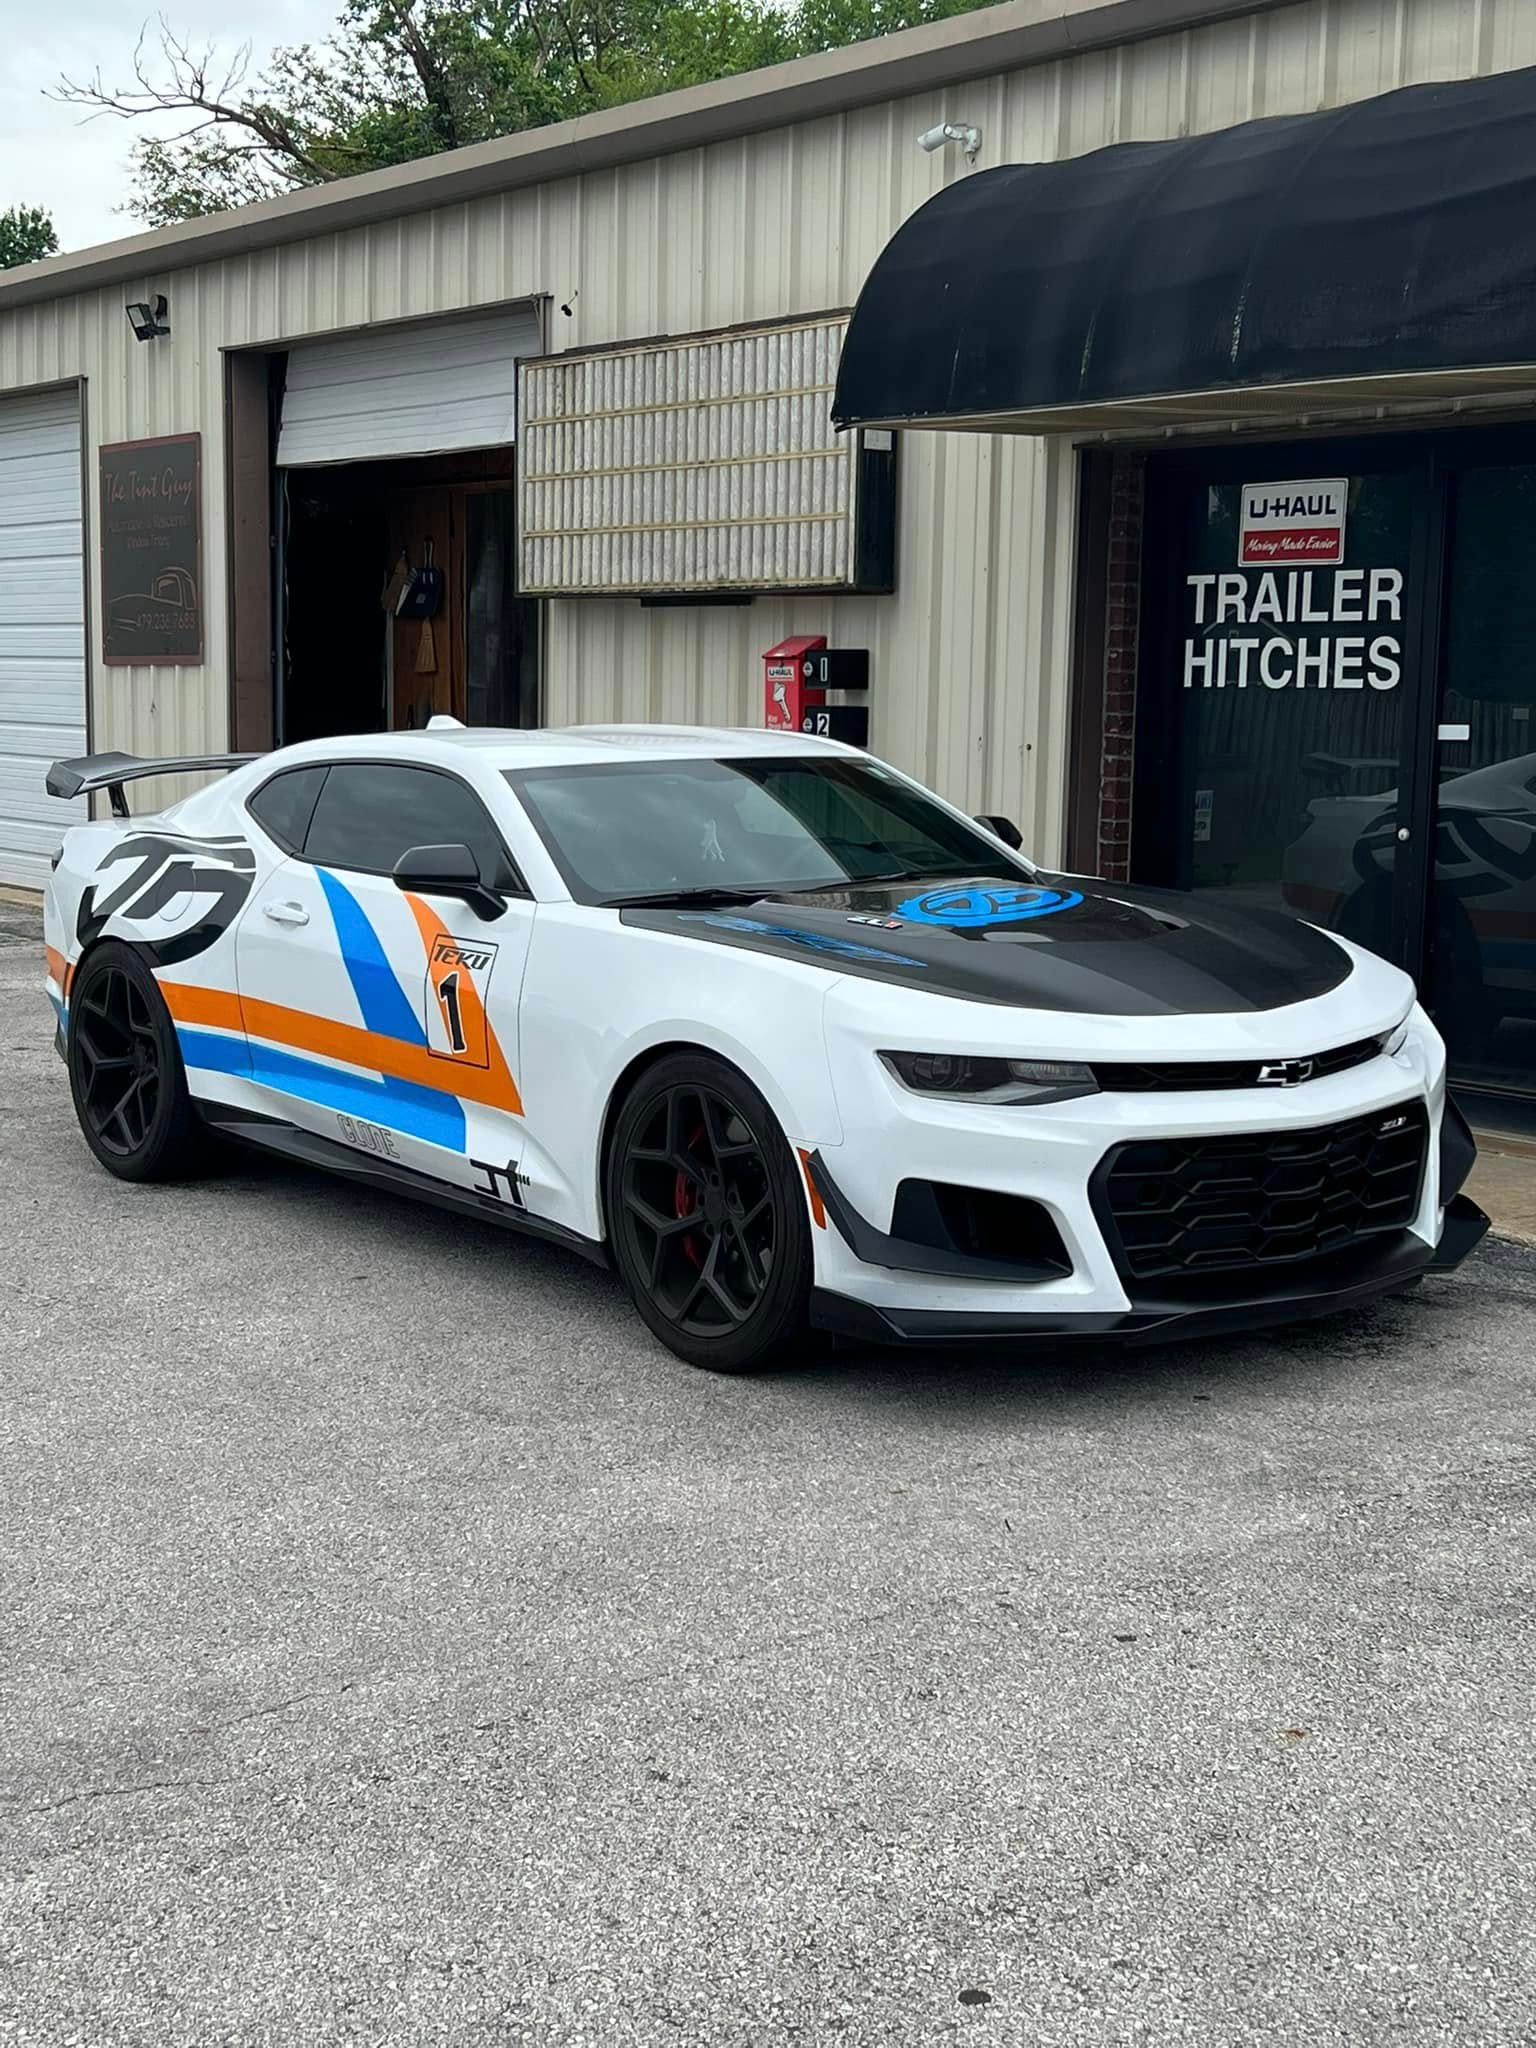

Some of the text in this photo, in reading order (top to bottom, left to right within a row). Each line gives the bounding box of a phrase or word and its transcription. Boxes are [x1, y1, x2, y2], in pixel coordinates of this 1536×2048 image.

[105, 467, 193, 506] The Tint Guy
[1249, 494, 1337, 519] U-HAUL
[1245, 535, 1337, 555] Moving Made Easier
[1186, 568, 1404, 624] TRAILER
[1183, 636, 1401, 690] HITCHES
[817, 713, 830, 737] 2
[433, 944, 493, 970] TEKU
[438, 971, 467, 1053] 1
[337, 1113, 400, 1159] CLONE
